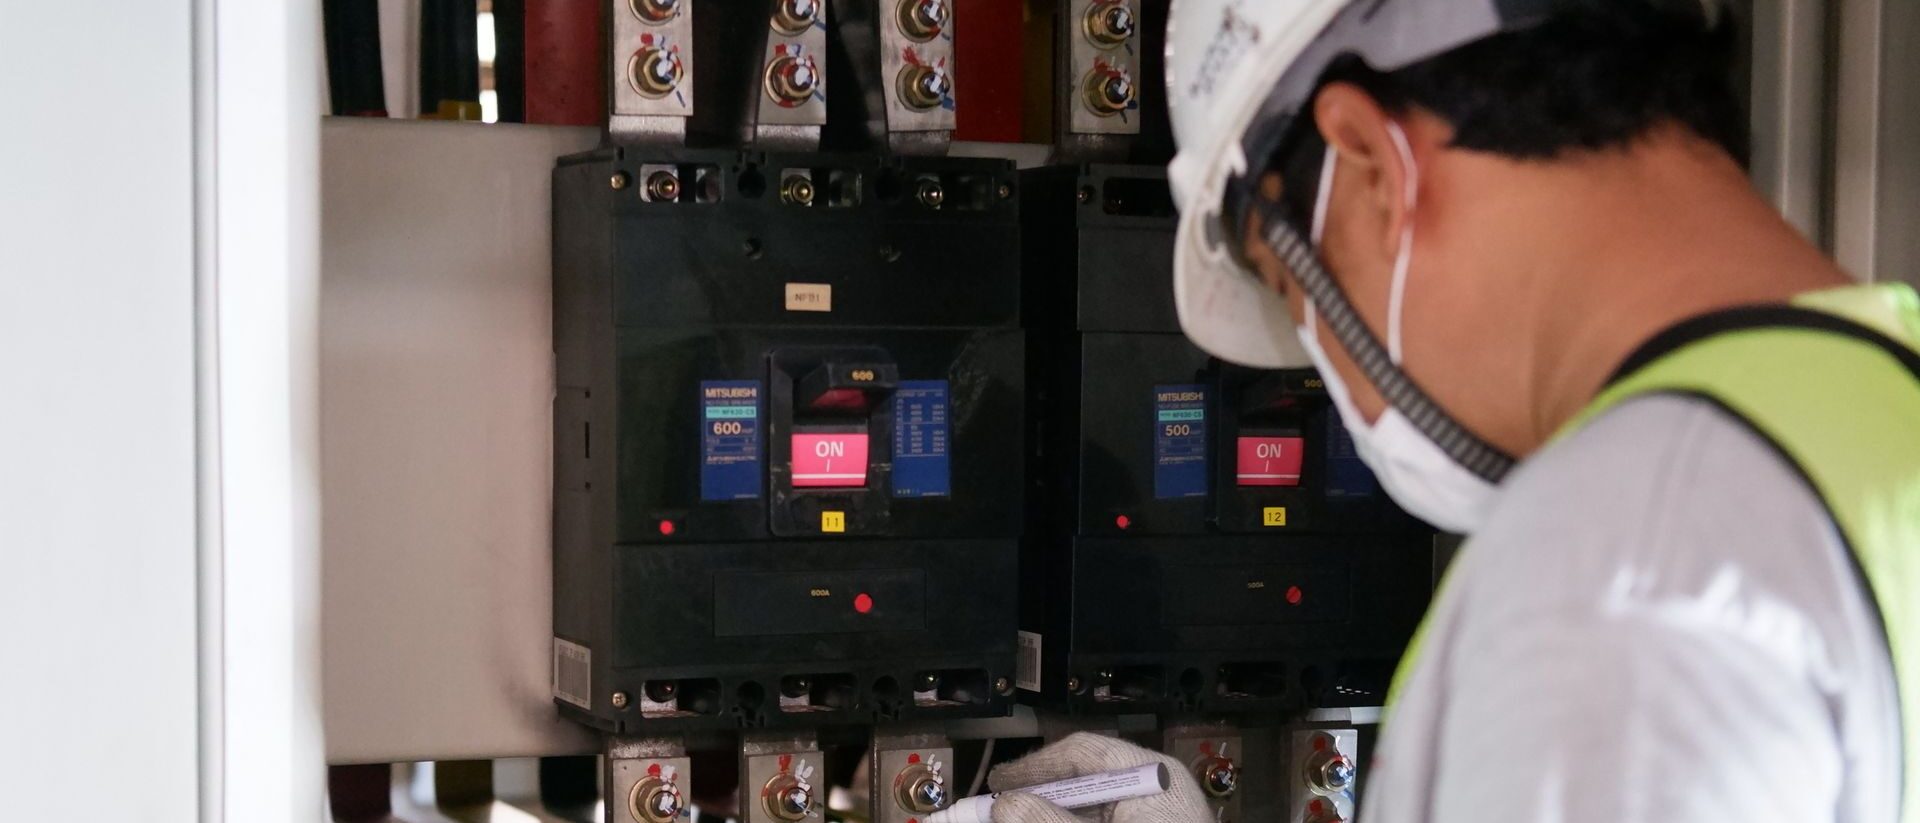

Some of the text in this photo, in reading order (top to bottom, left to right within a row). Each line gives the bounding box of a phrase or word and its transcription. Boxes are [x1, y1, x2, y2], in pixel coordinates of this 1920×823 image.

[851, 370, 875, 381] 600
[1303, 378, 1323, 389] 500
[705, 388, 757, 398] MITSUBISHI
[1157, 392, 1204, 401] MITSUBISHI
[713, 421, 742, 435] 600
[1165, 424, 1191, 437] 500
[815, 440, 844, 458] ON
[1256, 443, 1282, 458] ON
[1267, 511, 1282, 523] 12
[810, 589, 831, 598] 600A
